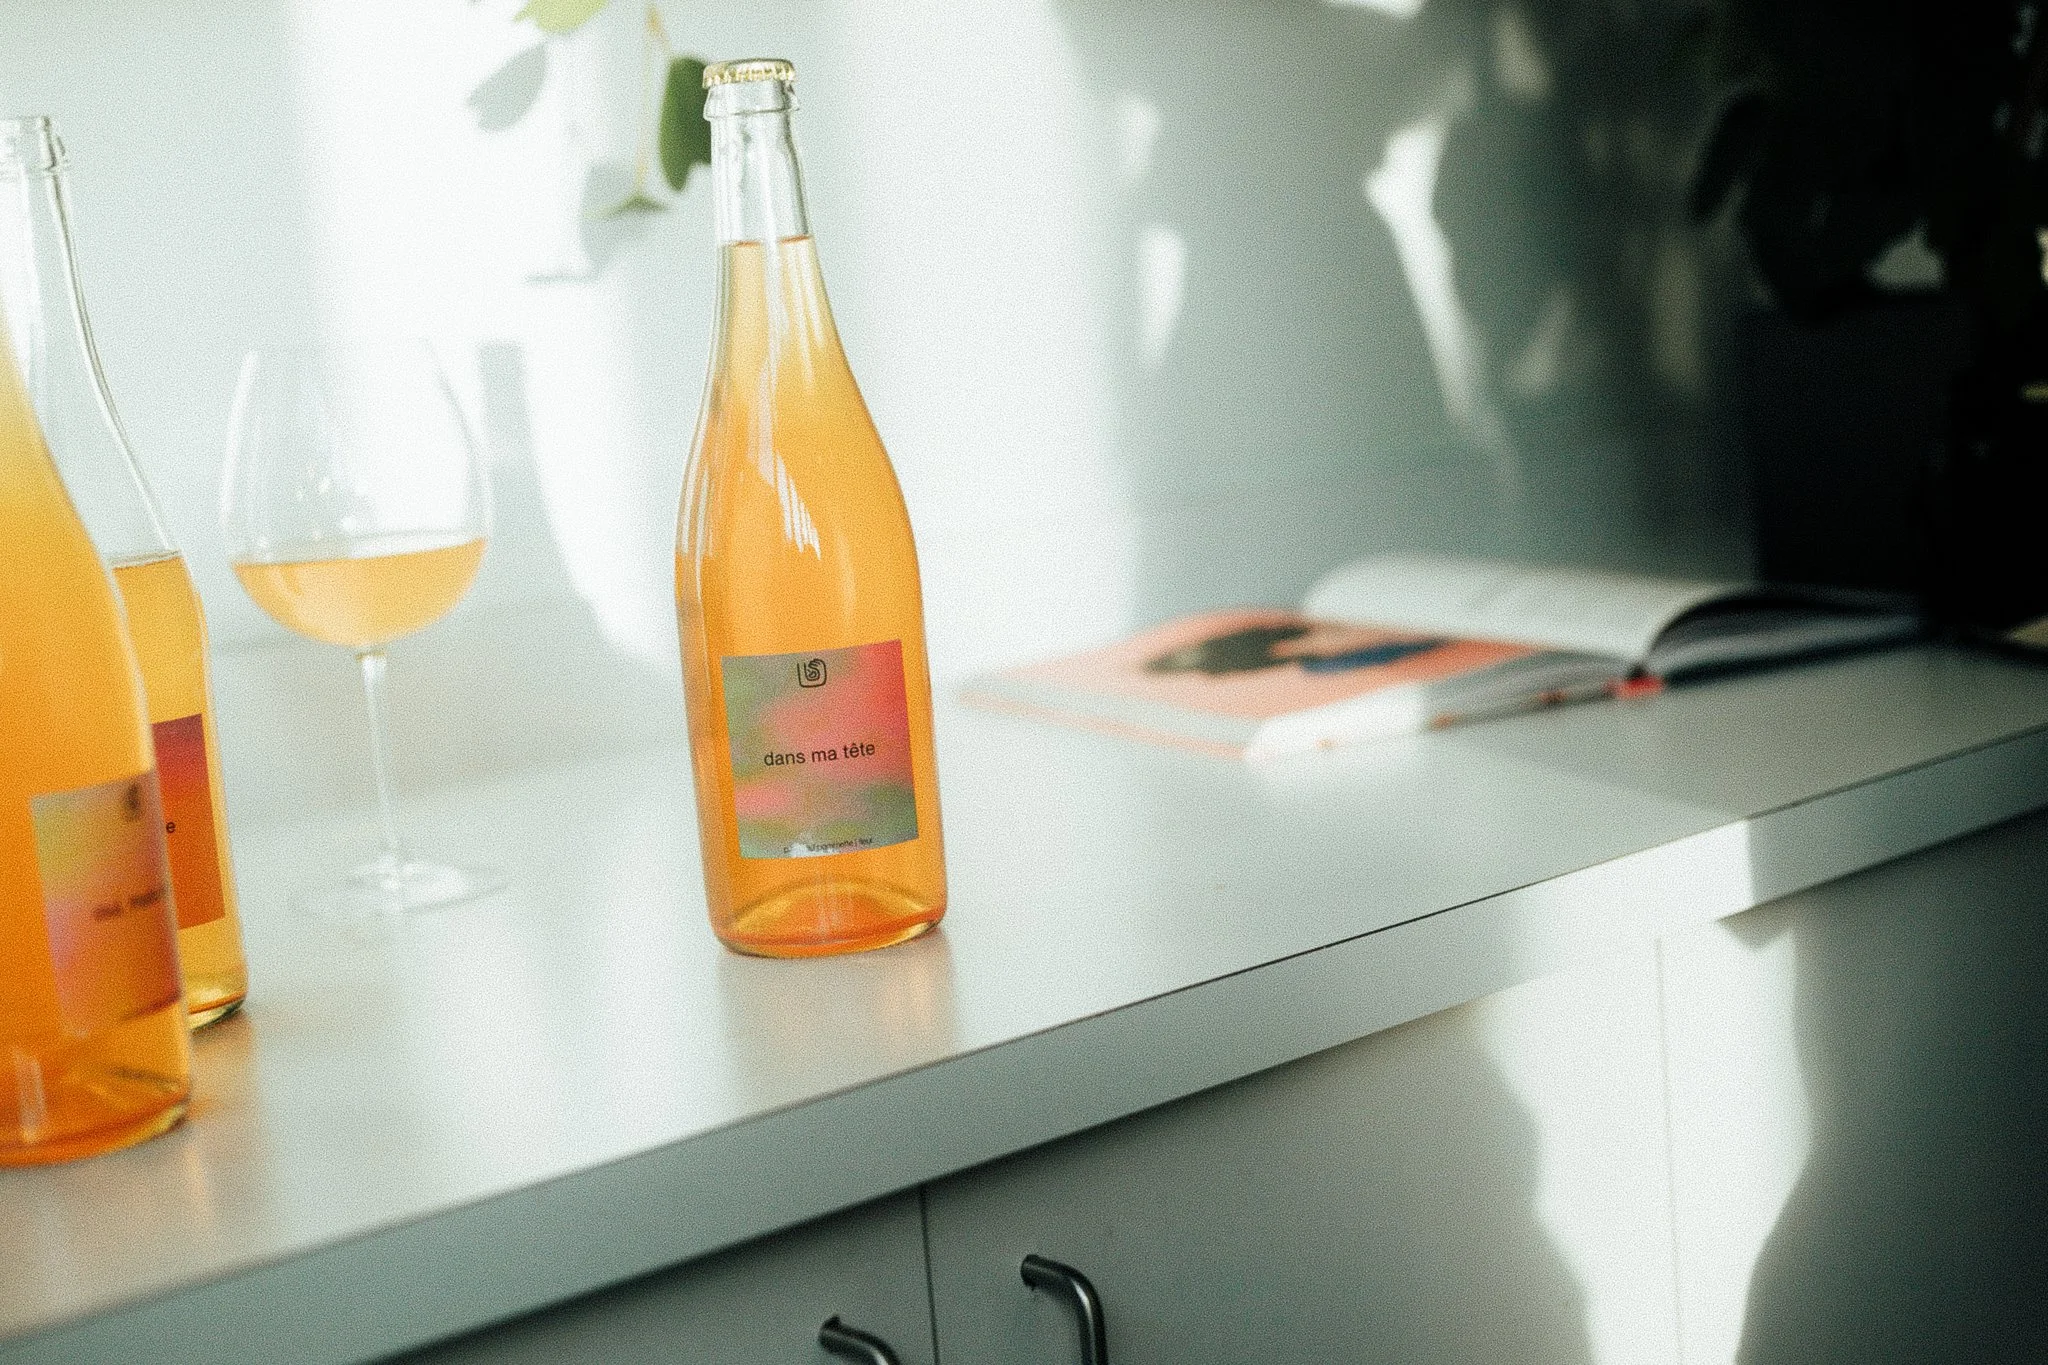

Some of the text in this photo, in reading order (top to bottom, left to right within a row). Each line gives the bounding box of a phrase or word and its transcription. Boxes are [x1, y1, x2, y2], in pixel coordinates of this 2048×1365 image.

[763, 742, 876, 767] dans ma tête
